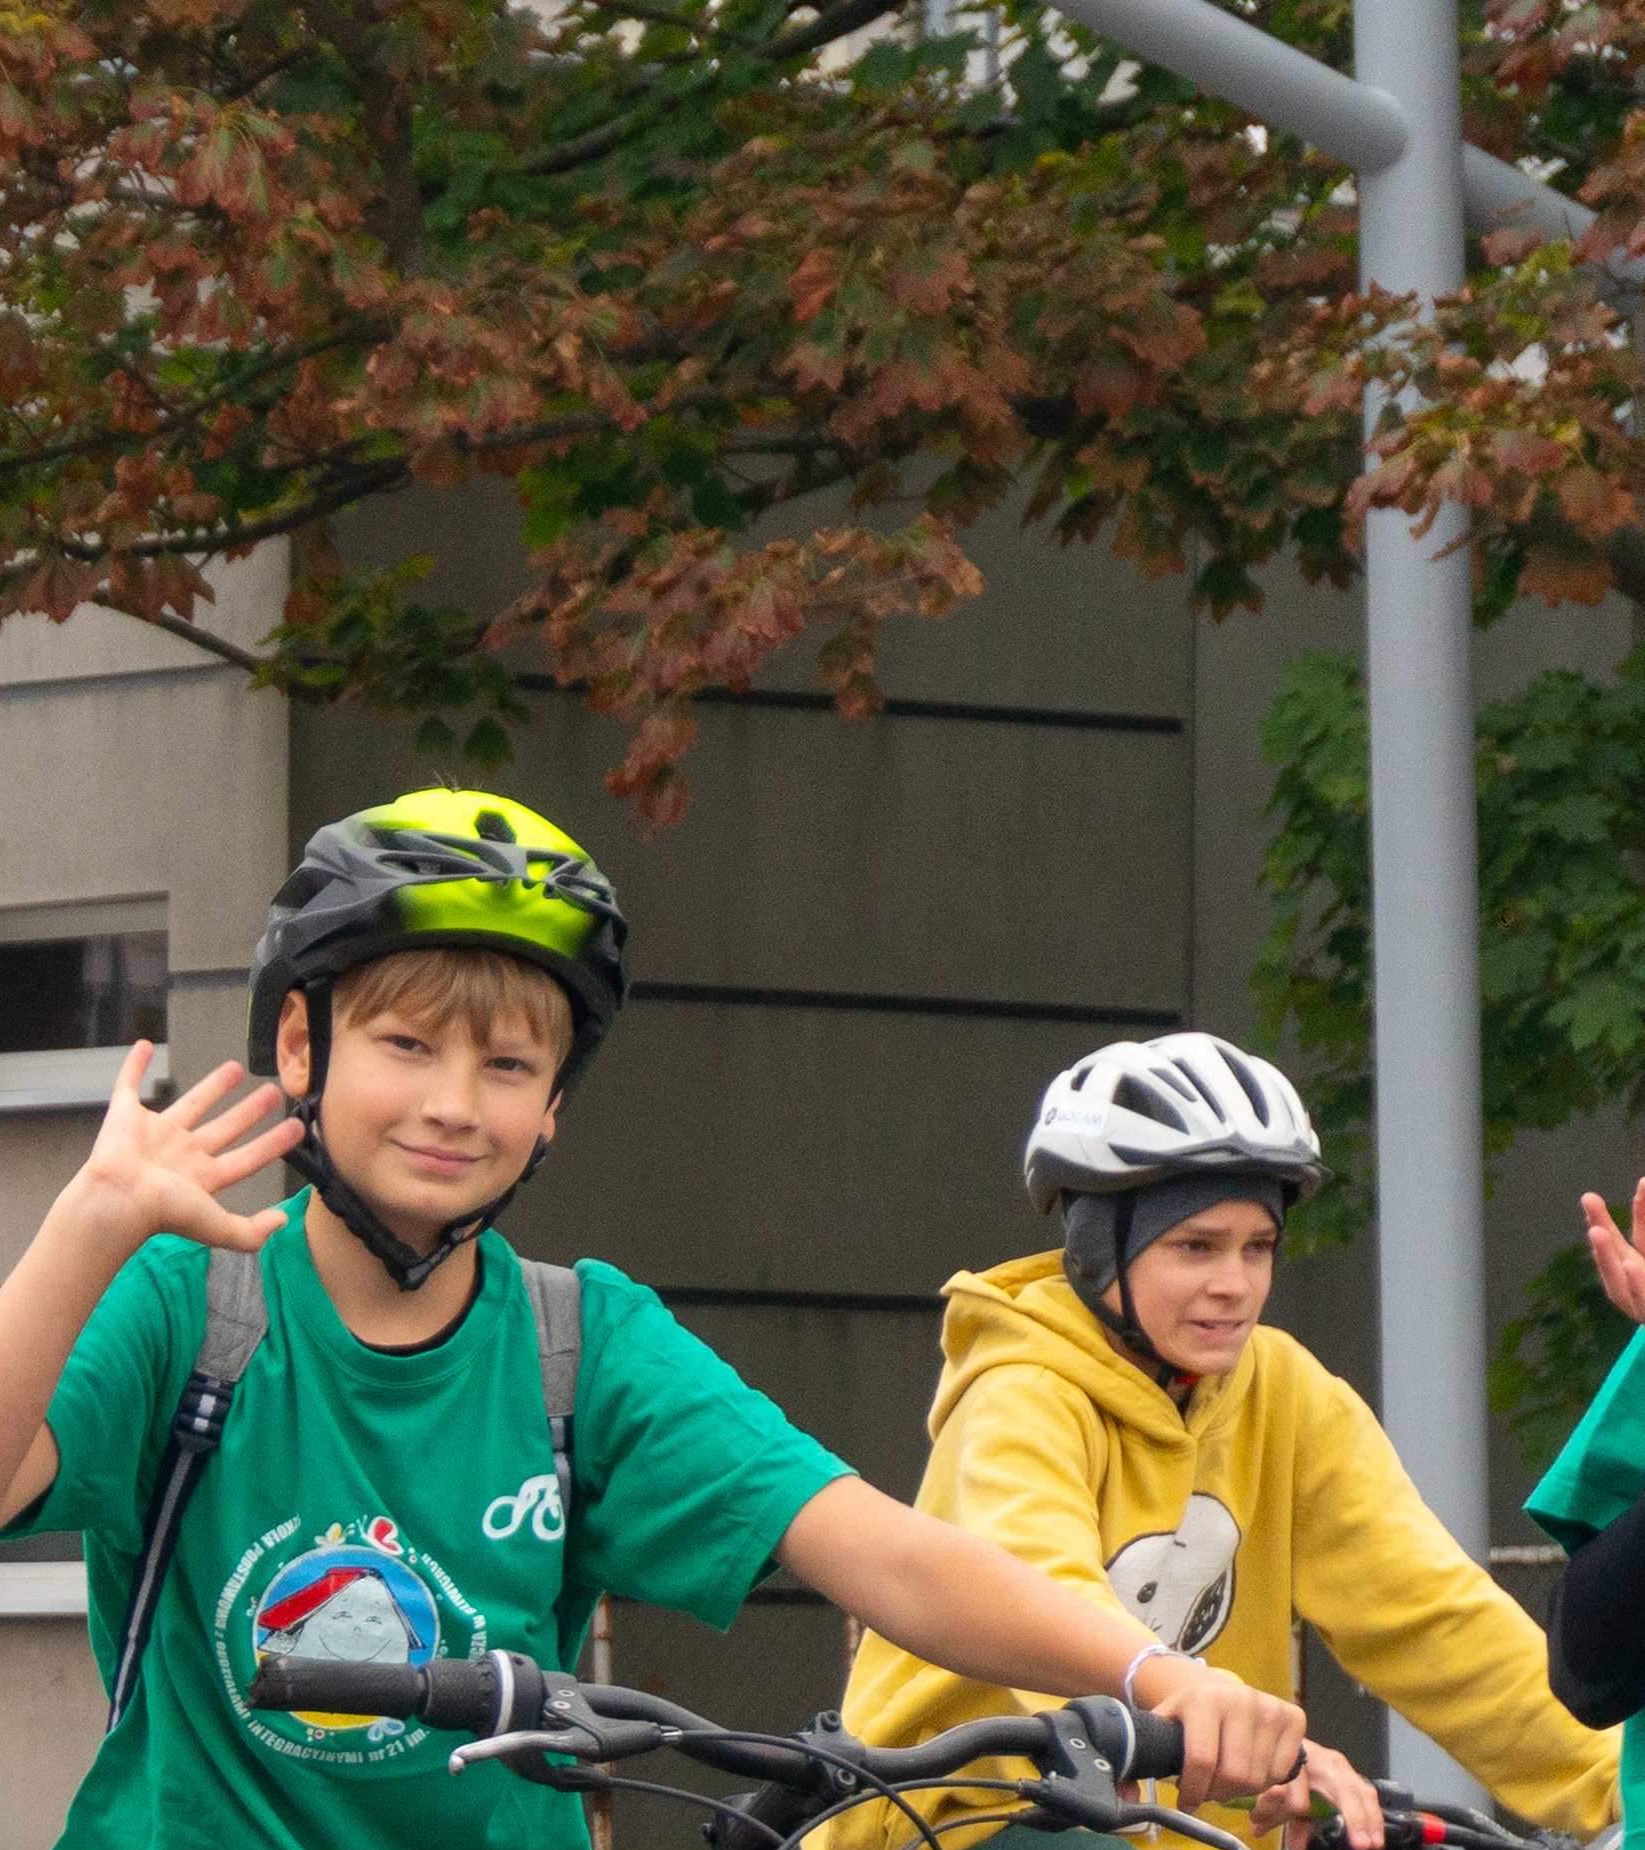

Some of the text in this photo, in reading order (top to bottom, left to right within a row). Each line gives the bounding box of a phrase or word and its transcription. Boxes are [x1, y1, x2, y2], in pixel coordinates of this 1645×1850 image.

[214, 1541, 265, 1629] PODSTAWOWA
[247, 1721, 365, 1764] INTEGRACYJNYMI
[386, 1741, 406, 1757] 21
